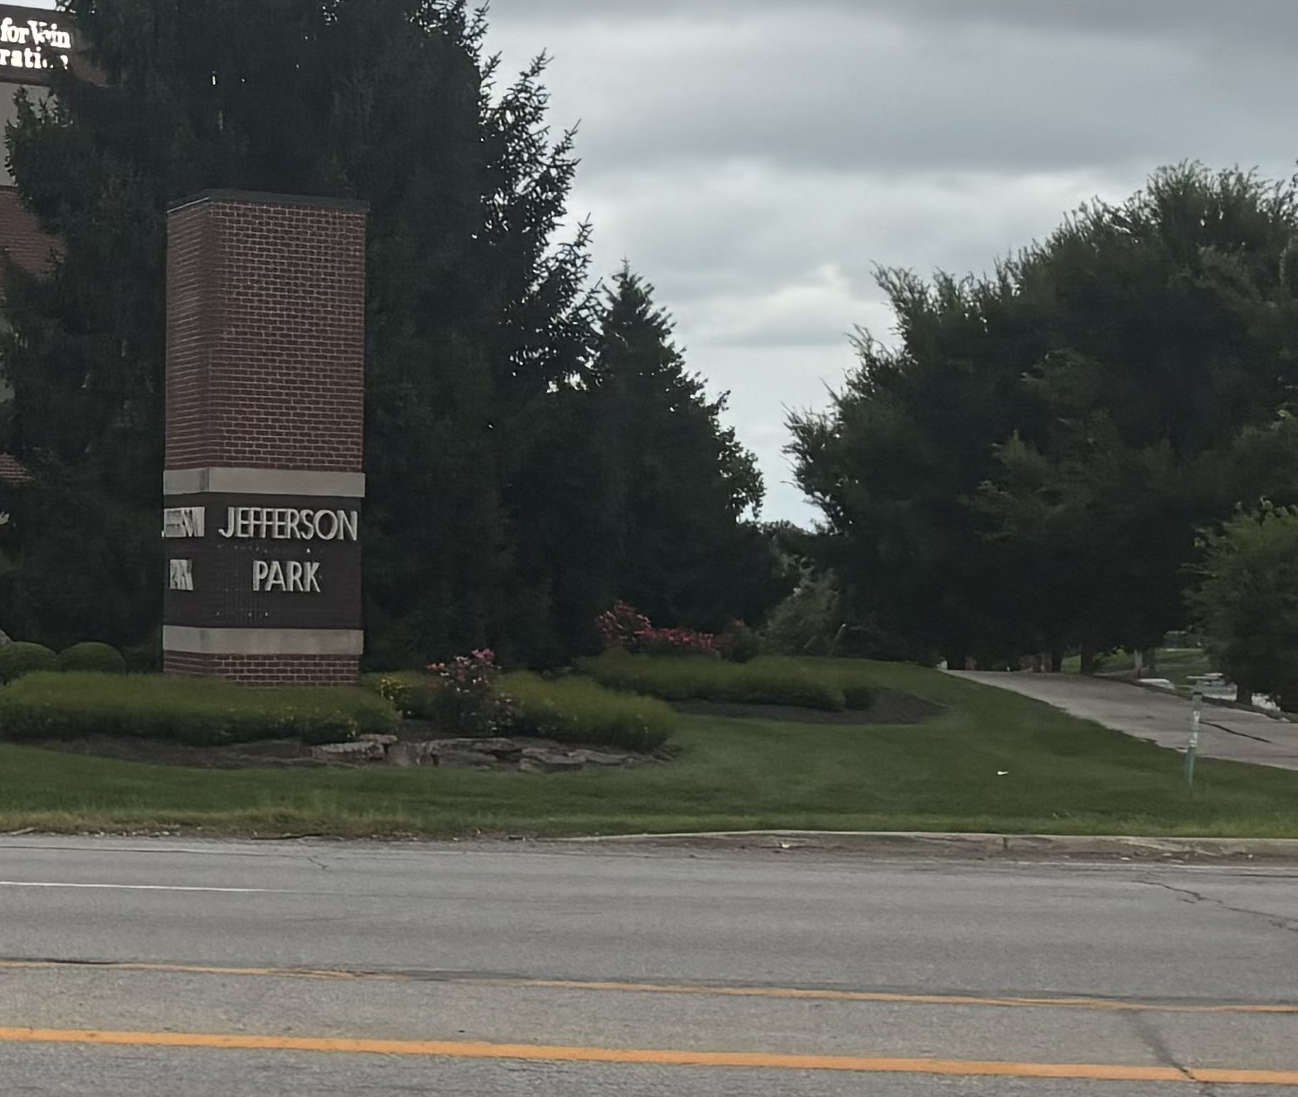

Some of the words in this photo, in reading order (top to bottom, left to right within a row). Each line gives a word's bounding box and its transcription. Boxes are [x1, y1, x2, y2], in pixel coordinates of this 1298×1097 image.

[0, 16, 30, 44] for
[218, 506, 358, 541] JEFFERSON
[252, 559, 321, 593] PARK
